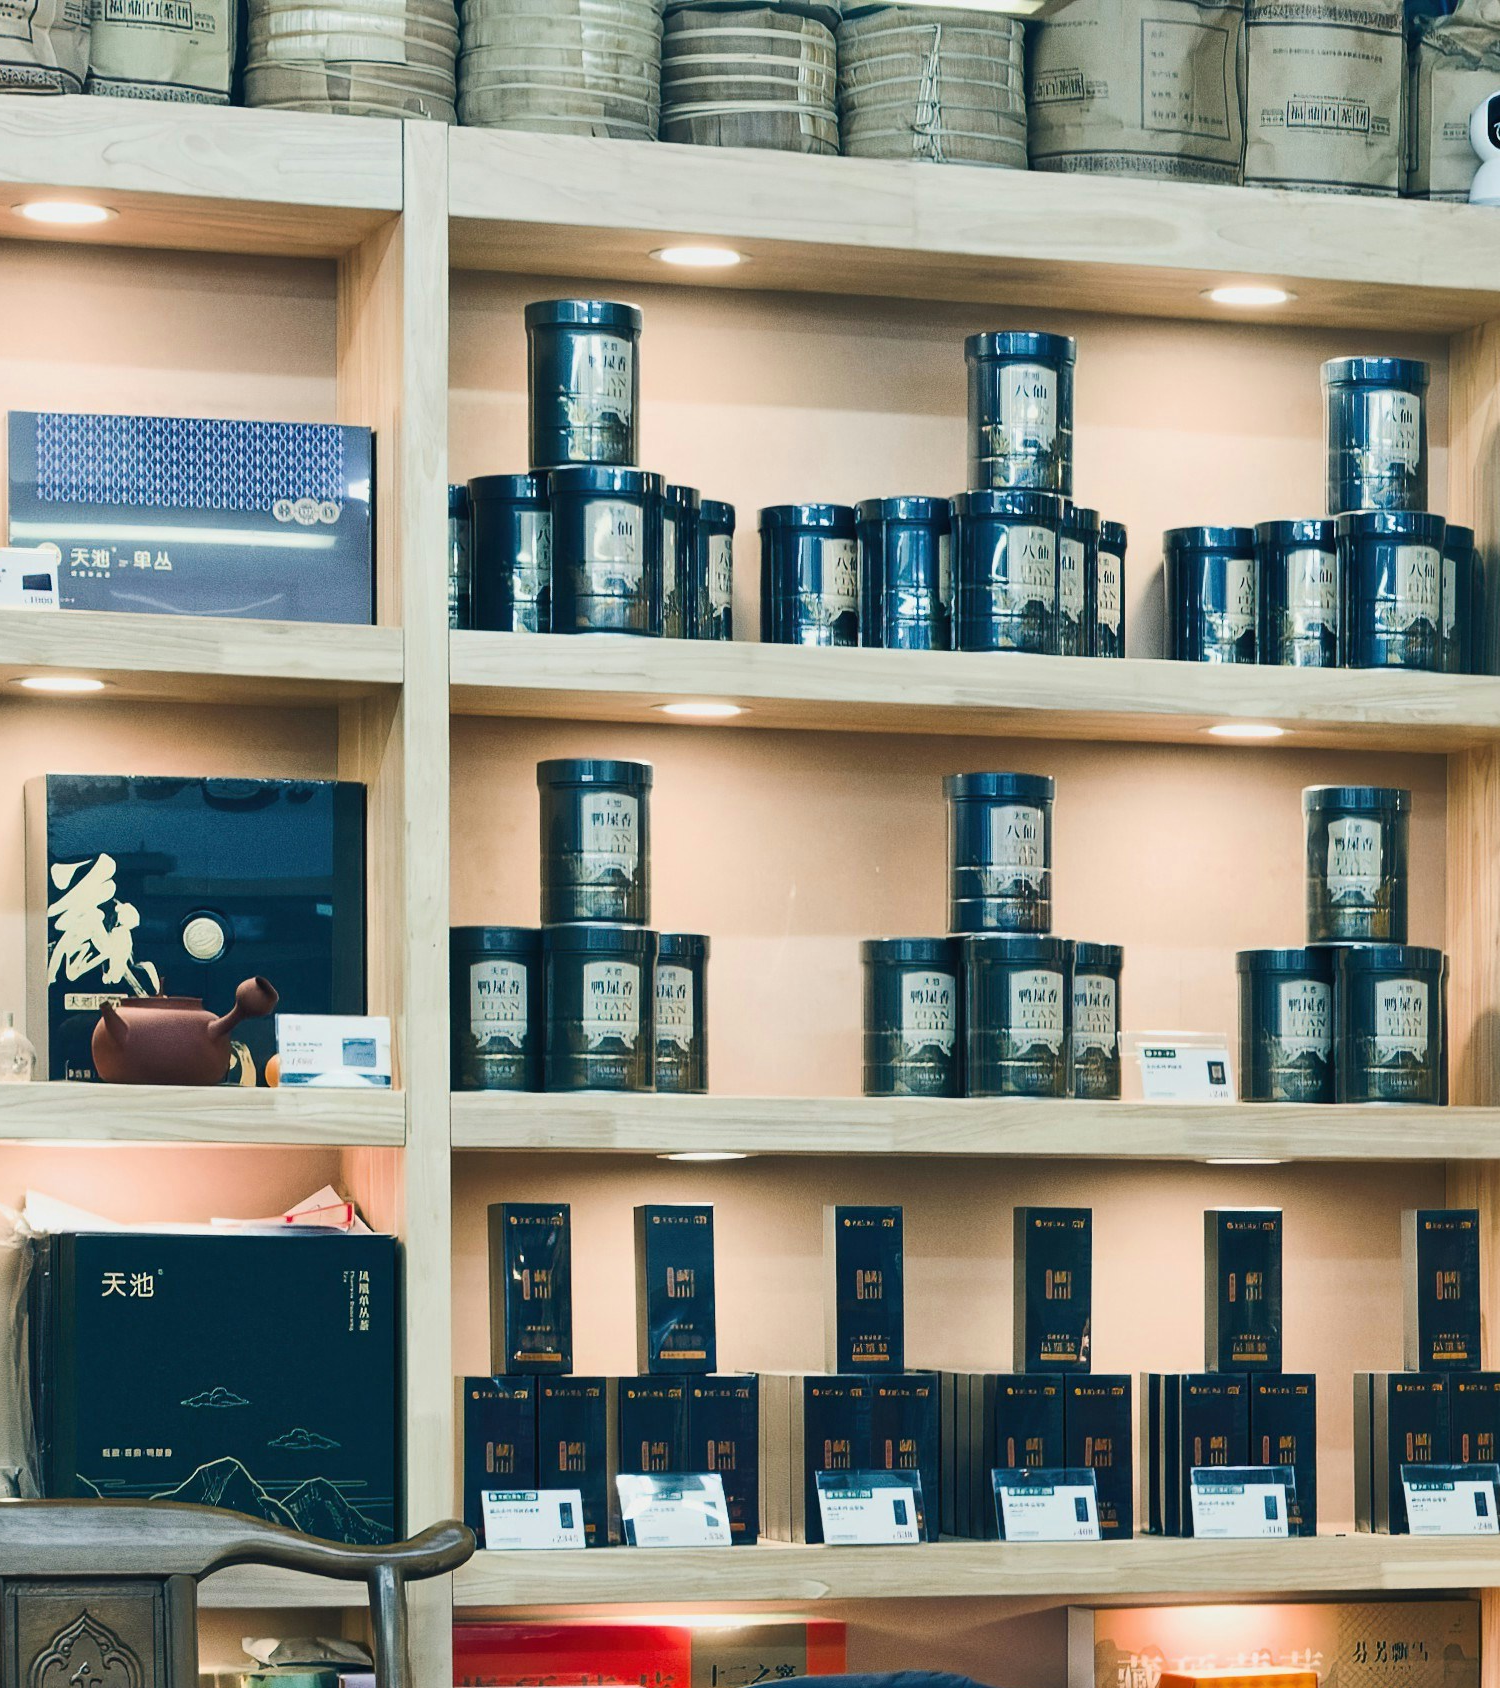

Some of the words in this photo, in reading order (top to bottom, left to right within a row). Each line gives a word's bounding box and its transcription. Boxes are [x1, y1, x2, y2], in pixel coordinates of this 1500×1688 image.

[1015, 384, 1047, 400] 八仙
[70, 547, 111, 569] 天池
[133, 551, 173, 571] 单丛
[1021, 543, 1049, 560] 八仙
[1409, 562, 1436, 579] 八仙
[591, 811, 631, 827] 鸭屎香
[1006, 824, 1036, 840] 八仙
[101, 1271, 155, 1298] 天池
